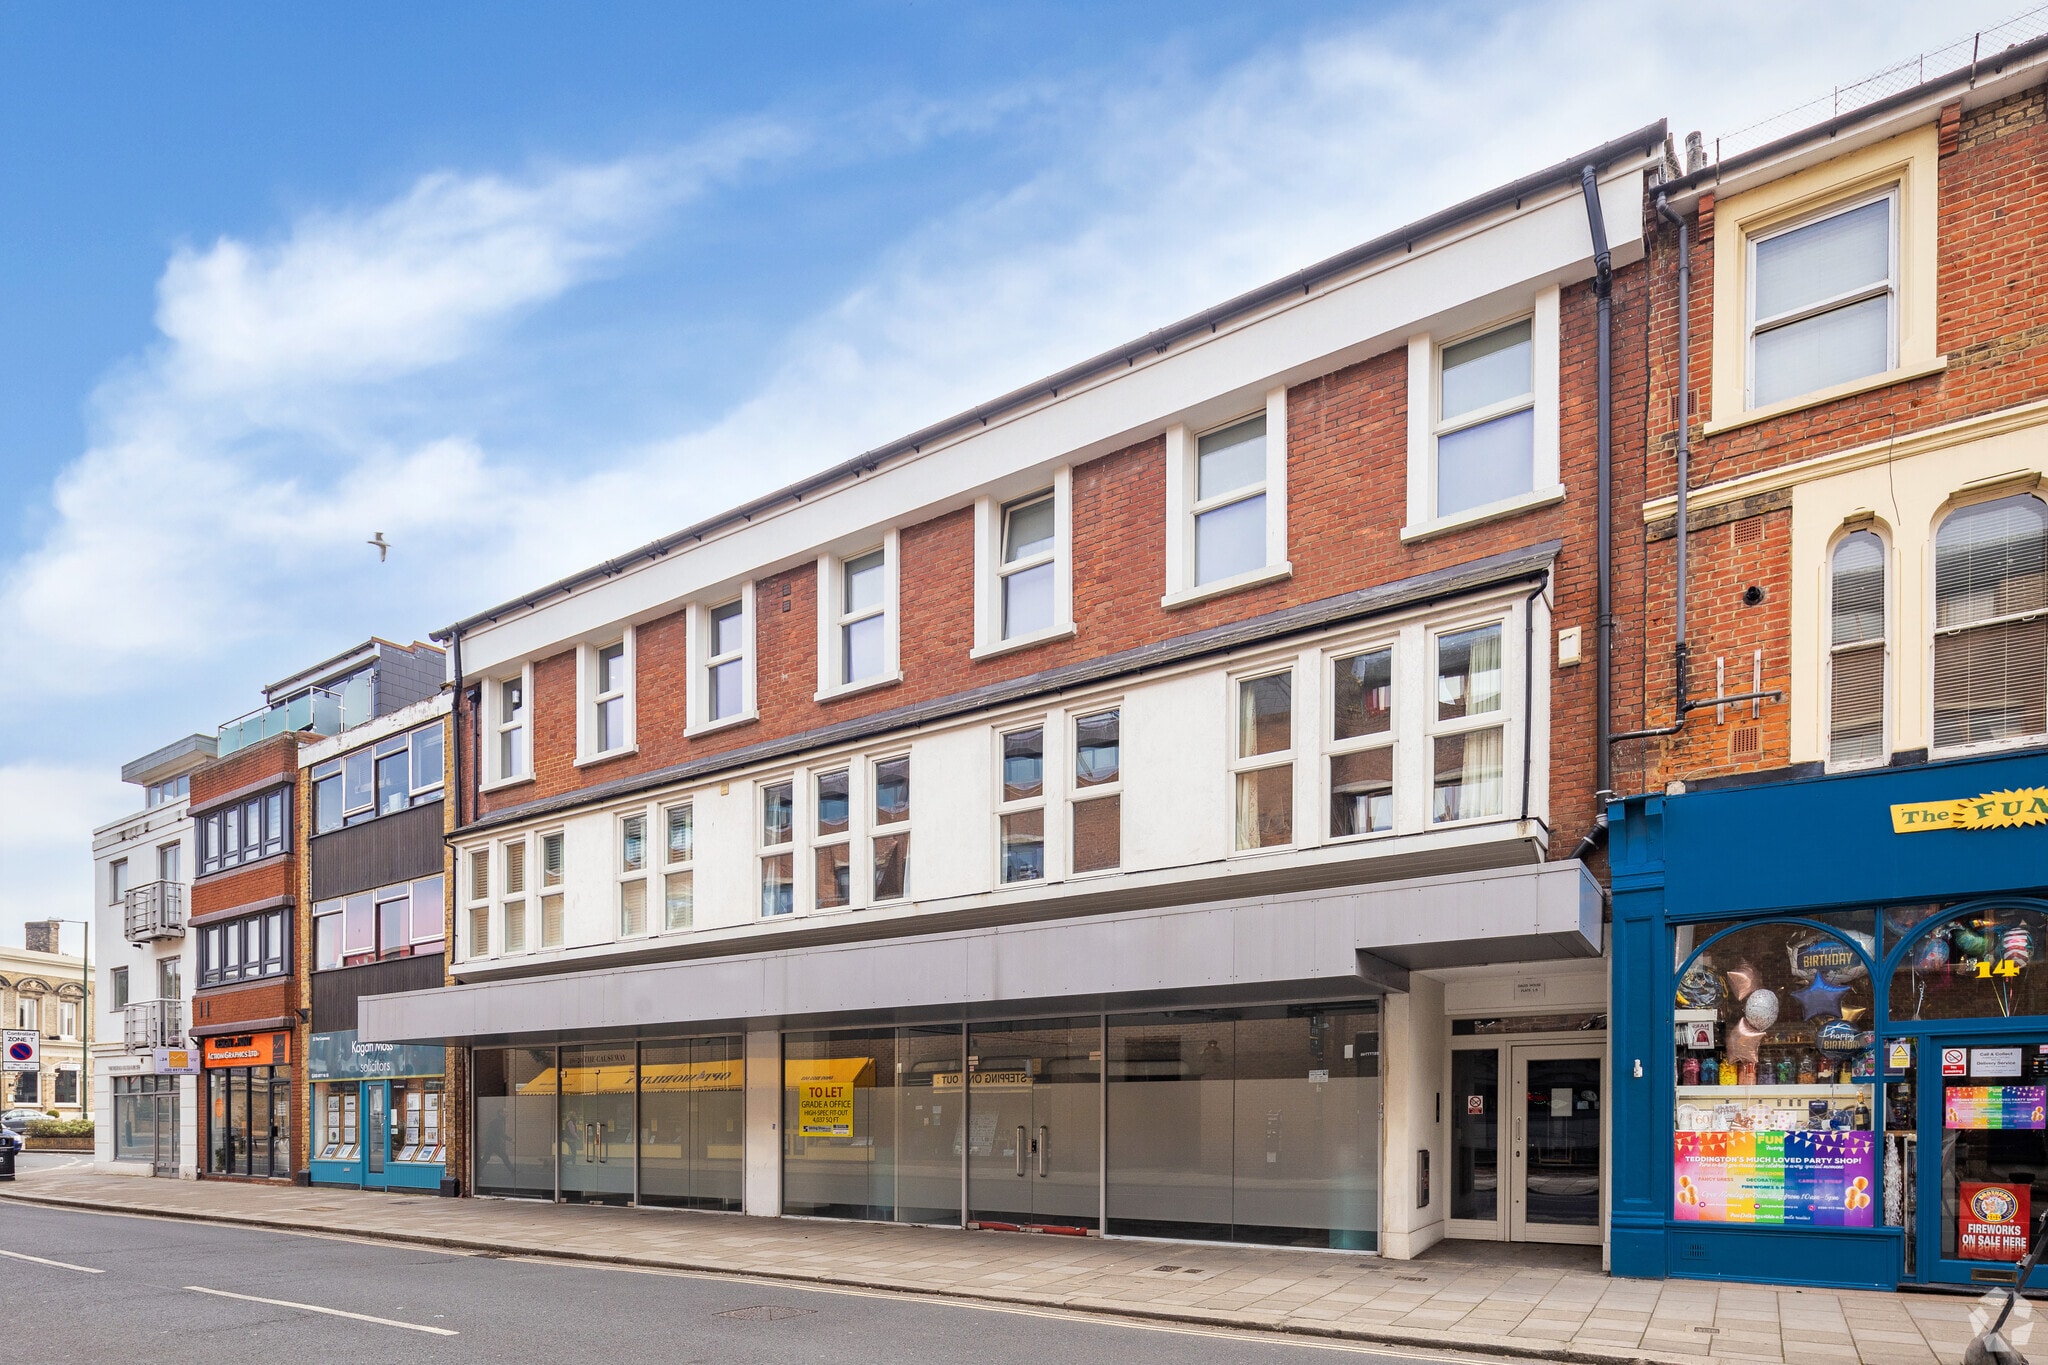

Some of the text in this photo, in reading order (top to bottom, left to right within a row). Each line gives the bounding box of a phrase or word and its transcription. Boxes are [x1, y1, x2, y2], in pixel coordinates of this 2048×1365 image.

[1901, 810, 1949, 825] The
[1803, 952, 1853, 968] BIRTHDAY
[1975, 959, 2020, 979] 14
[351, 1040, 394, 1056] Kagan Moss
[596, 1053, 627, 1064] CAUSEWAY
[360, 1058, 391, 1073] solicitors
[809, 1086, 844, 1098] TO LET
[801, 1100, 822, 1108] GRADE
[829, 1100, 851, 1108] OFFICE
[1695, 1116, 1710, 1125] 60
[1757, 1135, 1784, 1145] FUN
[1701, 1191, 1717, 1199] Open
[1718, 1191, 1745, 1201] Monday
[1753, 1192, 1784, 1201] Saturday
[1784, 1193, 1800, 1202] from
[1740, 1212, 1760, 1220] Delivery
[1968, 1223, 2021, 1236] FIREWORKS
[1962, 1234, 2027, 1247] ON SALE HERE
